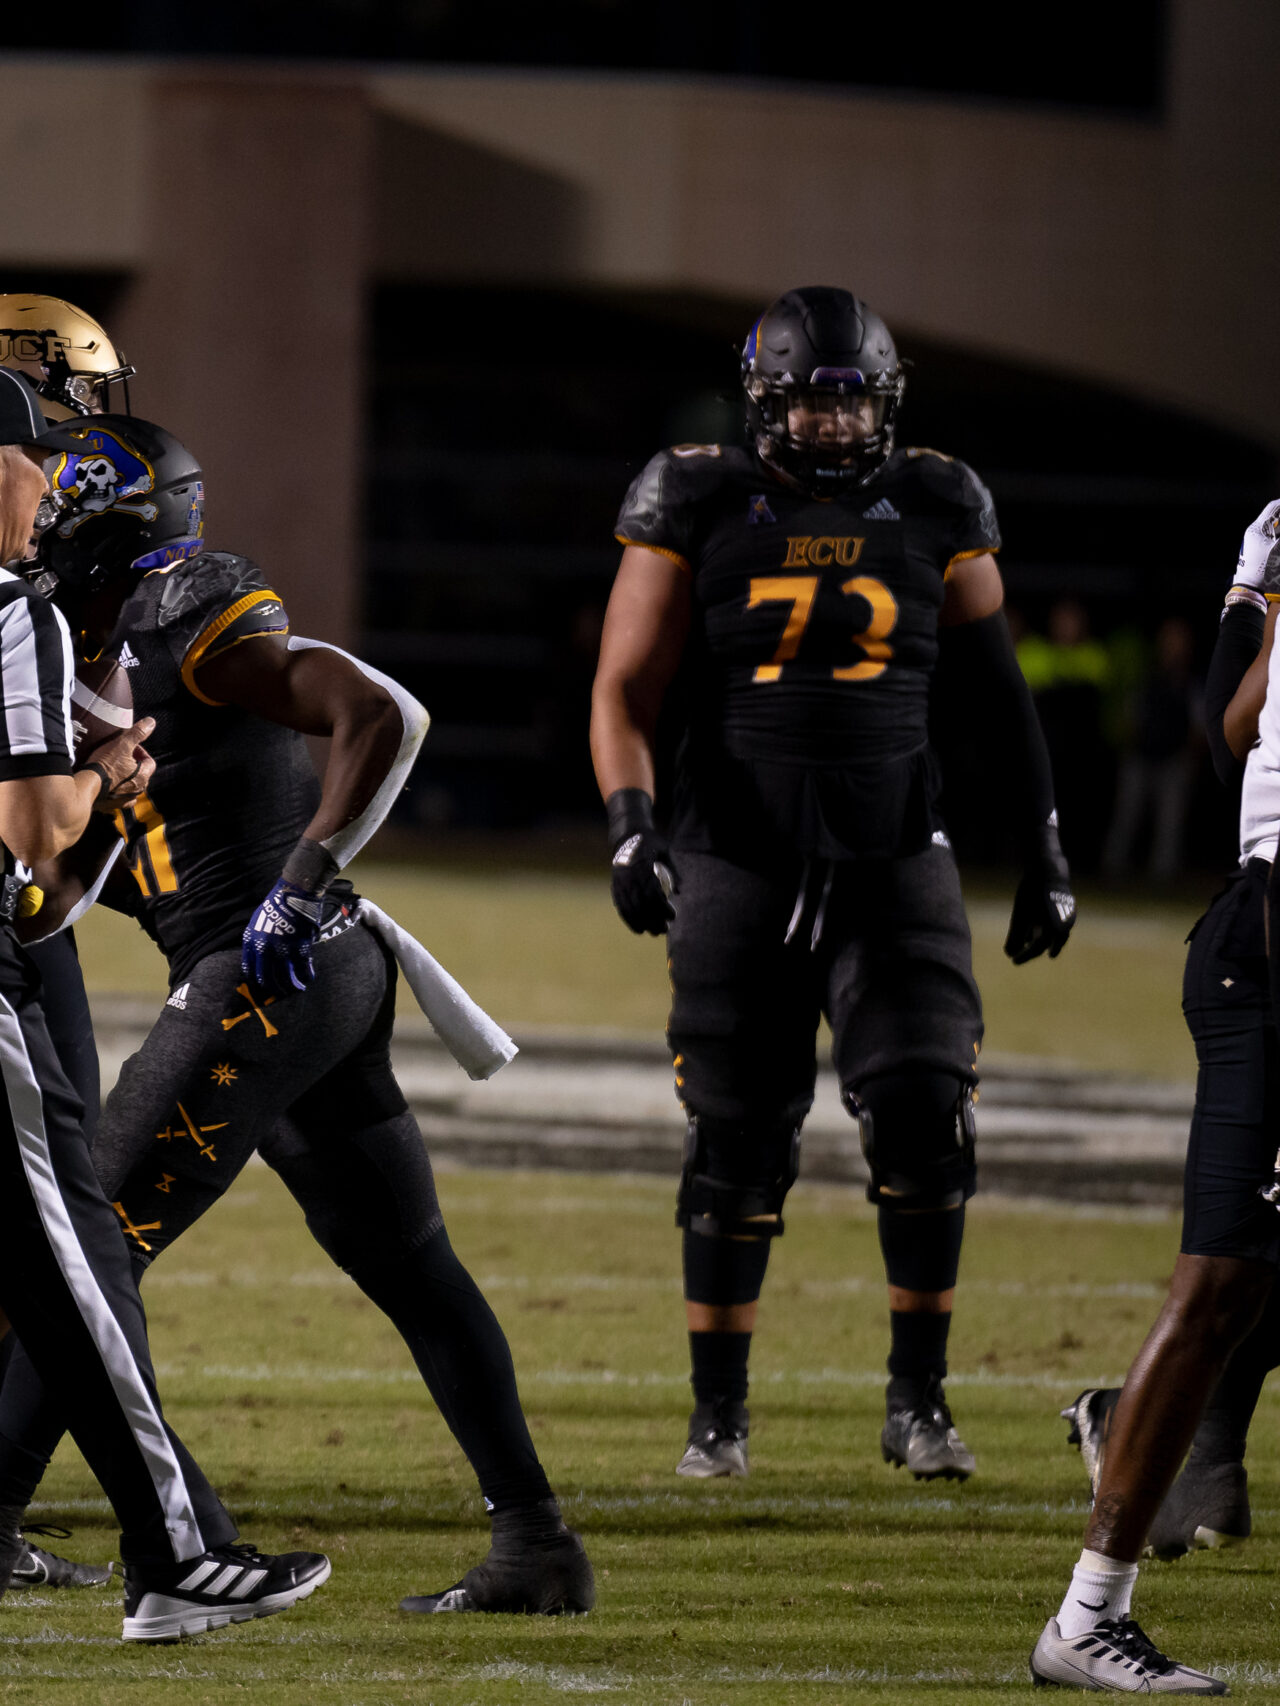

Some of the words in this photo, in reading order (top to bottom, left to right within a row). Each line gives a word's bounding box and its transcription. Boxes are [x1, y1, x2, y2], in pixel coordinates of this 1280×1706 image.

[781, 535, 867, 568] ECU
[746, 574, 899, 683] 73
[111, 790, 181, 900] 1
[262, 899, 297, 935] adidas
